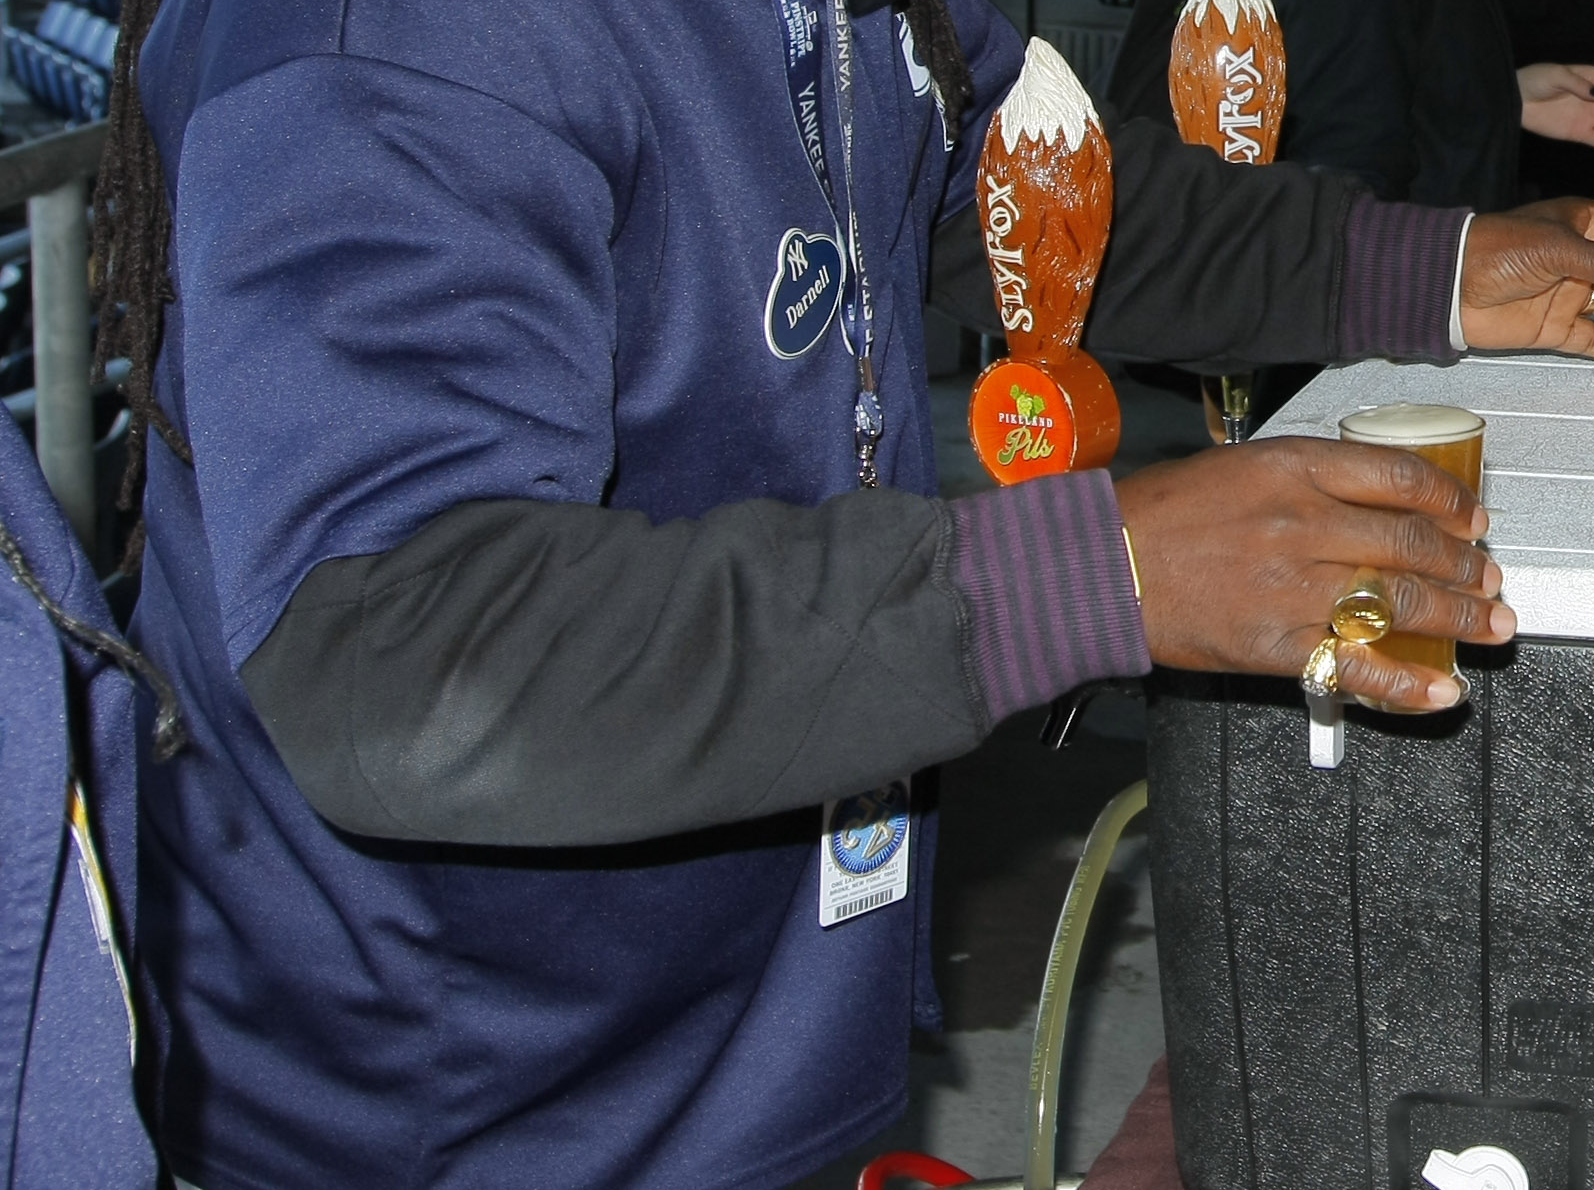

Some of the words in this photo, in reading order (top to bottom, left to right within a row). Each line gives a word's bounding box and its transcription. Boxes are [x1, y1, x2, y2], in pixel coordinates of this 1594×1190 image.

[797, 81, 825, 175] YANKEE
[785, 264, 830, 329] Darnell
[997, 426, 1056, 466] Pils
[998, 411, 1054, 429] PIKELAND
